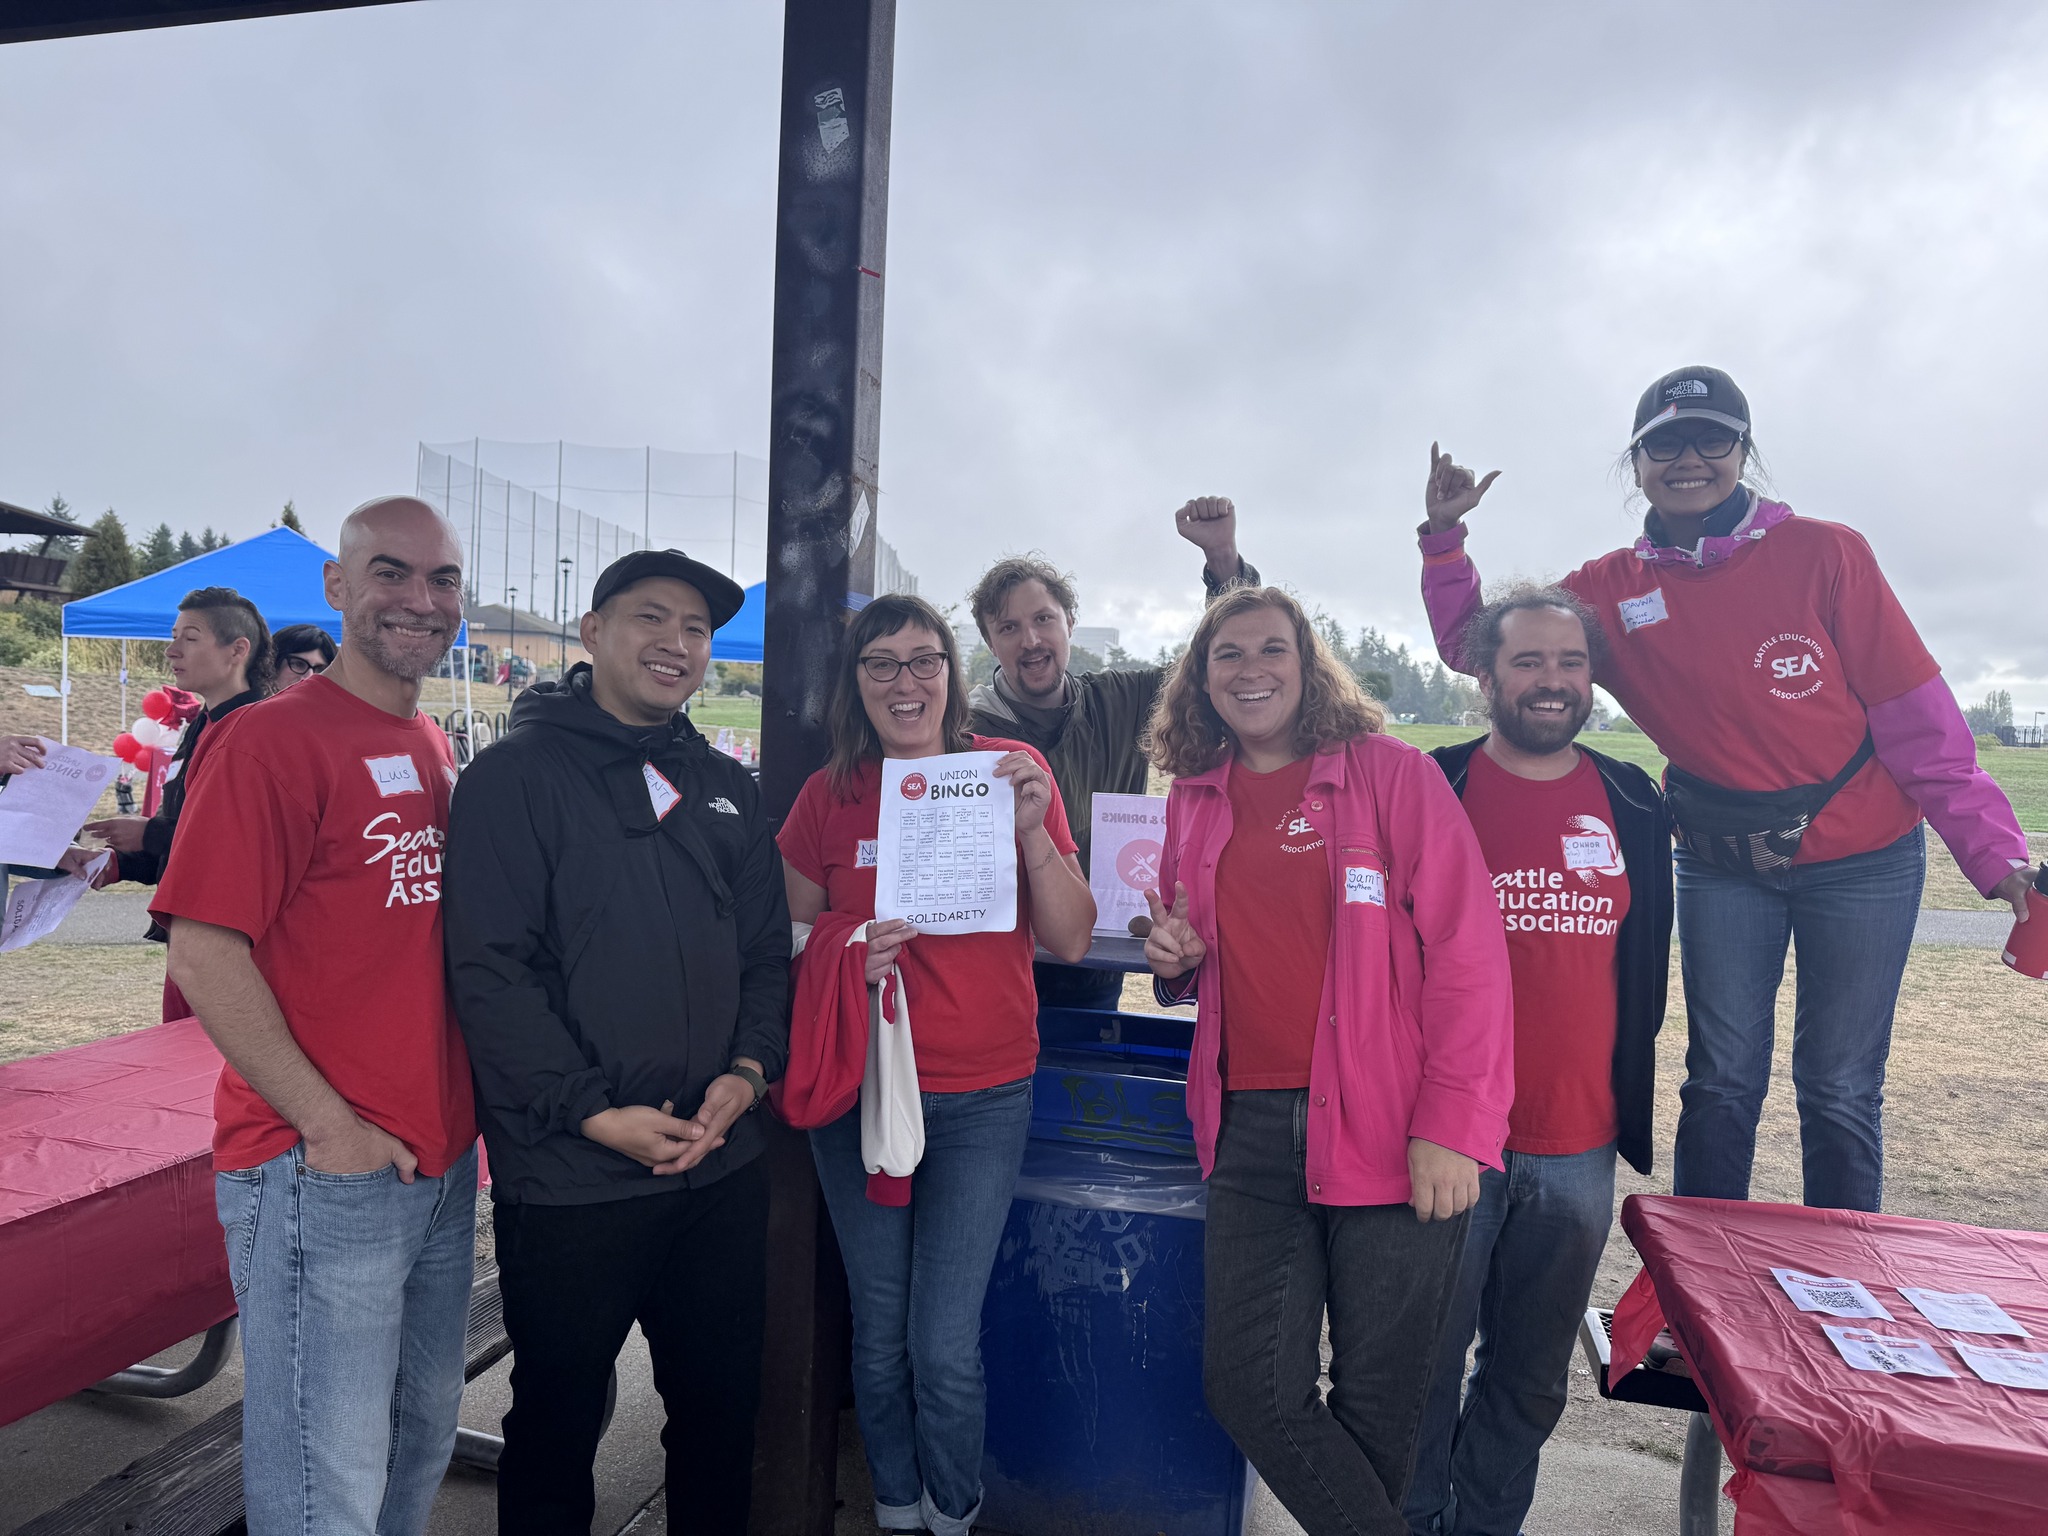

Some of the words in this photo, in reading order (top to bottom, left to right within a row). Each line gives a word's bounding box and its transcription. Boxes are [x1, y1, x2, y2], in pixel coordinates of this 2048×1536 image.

[1665, 384, 1693, 395] NORTH
[1677, 380, 1693, 388] THE
[1672, 389, 1693, 397] FACE
[1754, 636, 1779, 668] SEATTLE
[1779, 633, 1825, 660] EDUCATION
[1771, 653, 1820, 679] SEA
[1769, 679, 1824, 700] ASSOCIATION
[378, 766, 411, 783] Luis
[940, 769, 978, 781] UNION
[906, 782, 922, 790] SEA
[930, 783, 989, 800] BINGO
[1287, 817, 1315, 836] SE
[1280, 838, 1325, 853] ASSOCIATIO
[390, 850, 445, 880] Edu
[1348, 868, 1374, 884] Sam
[1490, 868, 1563, 889] attle
[906, 909, 987, 925] SOLIDARITY
[1501, 913, 1618, 936] sociation
